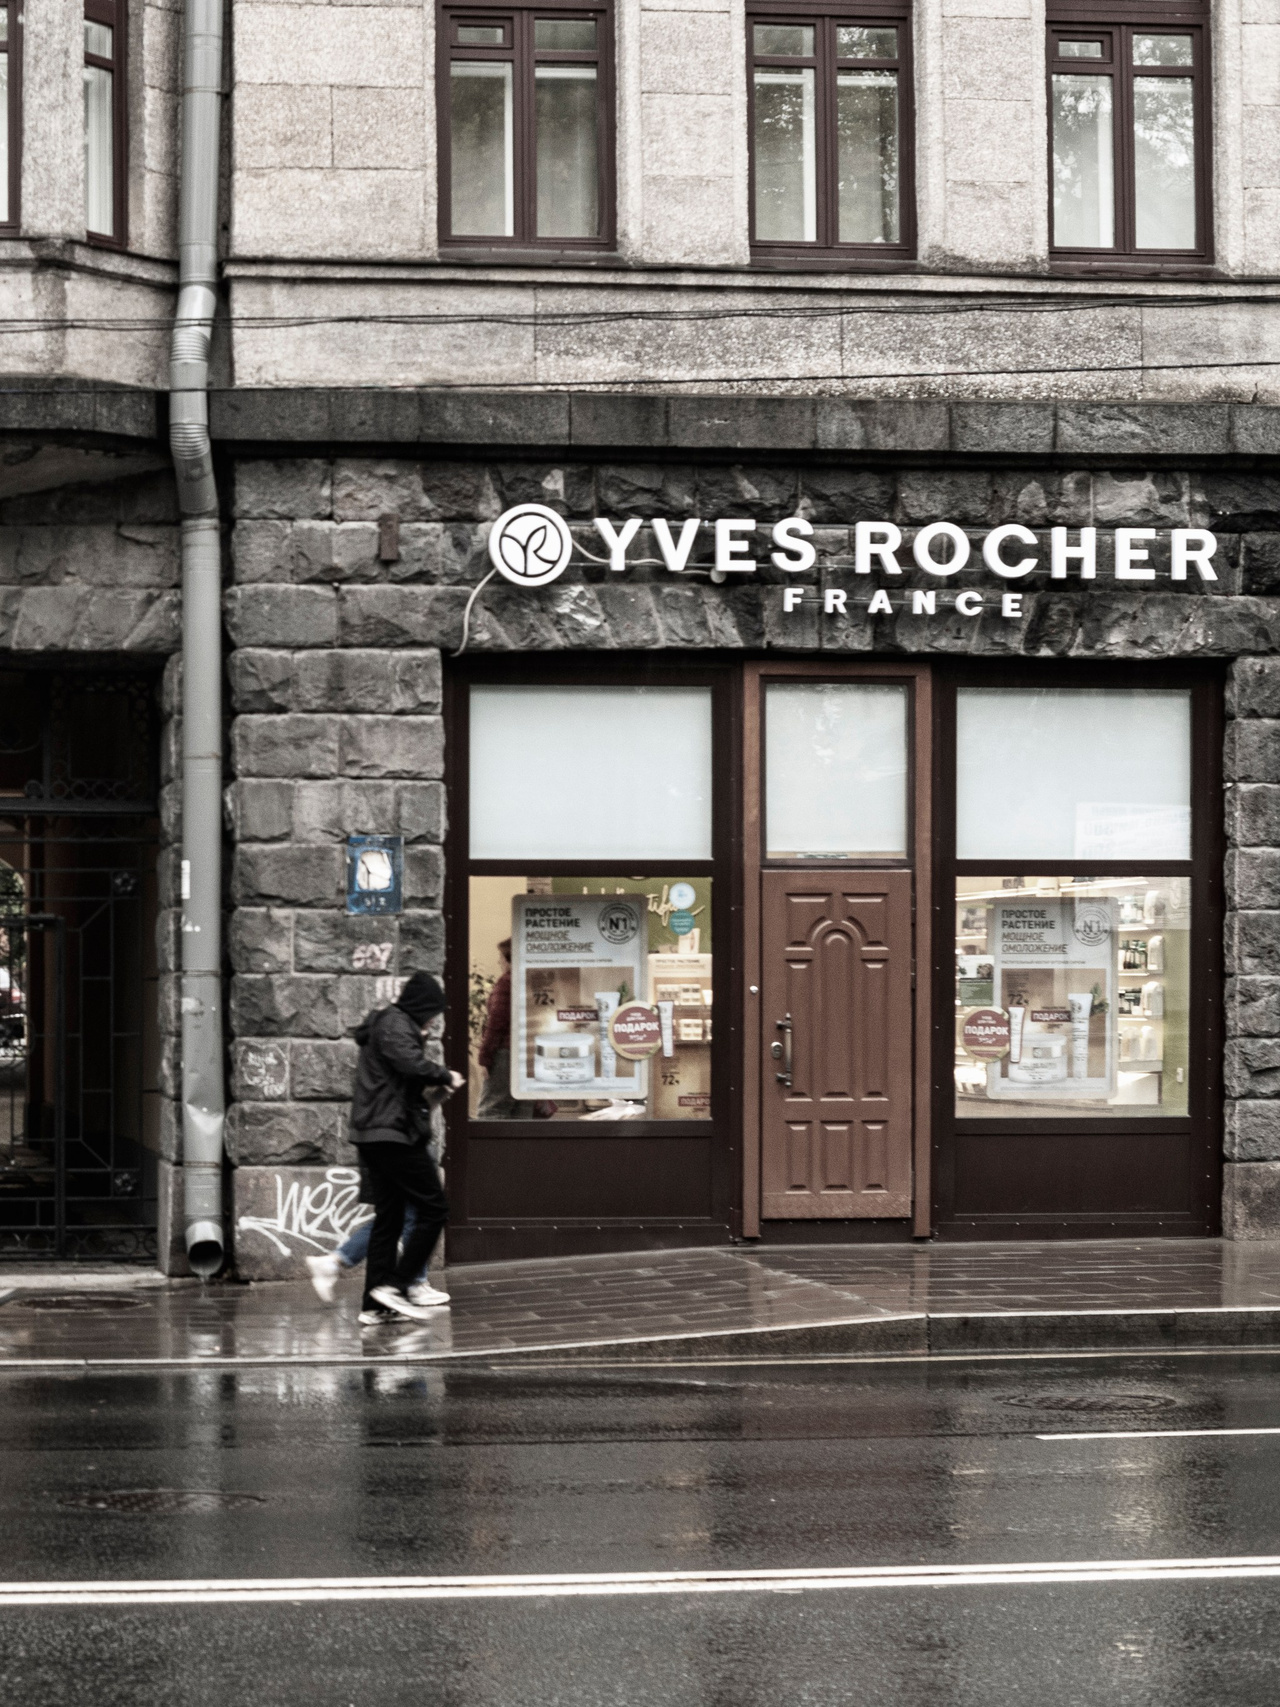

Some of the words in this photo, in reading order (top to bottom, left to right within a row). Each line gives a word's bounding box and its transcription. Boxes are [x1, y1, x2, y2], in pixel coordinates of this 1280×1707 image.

[593, 515, 816, 573] YVES
[854, 520, 1219, 581] ROCHER
[782, 587, 1024, 618] FRANCE
[525, 907, 571, 917] ПРОСТОЕ
[1001, 910, 1047, 919] ПРОСТОЕ
[525, 918, 580, 928] РАСТЕНИЕ
[1001, 920, 1056, 929] РАСТЕНИЕ
[1001, 932, 1045, 942] МОЩНОЕ
[1001, 944, 1068, 953] ОМОЛОЖЕНИЕ
[1033, 1012, 1070, 1021] ПОДАРОК
[613, 1022, 660, 1034] ПОДАРОК
[964, 1025, 1009, 1036] ПОДАРОК
